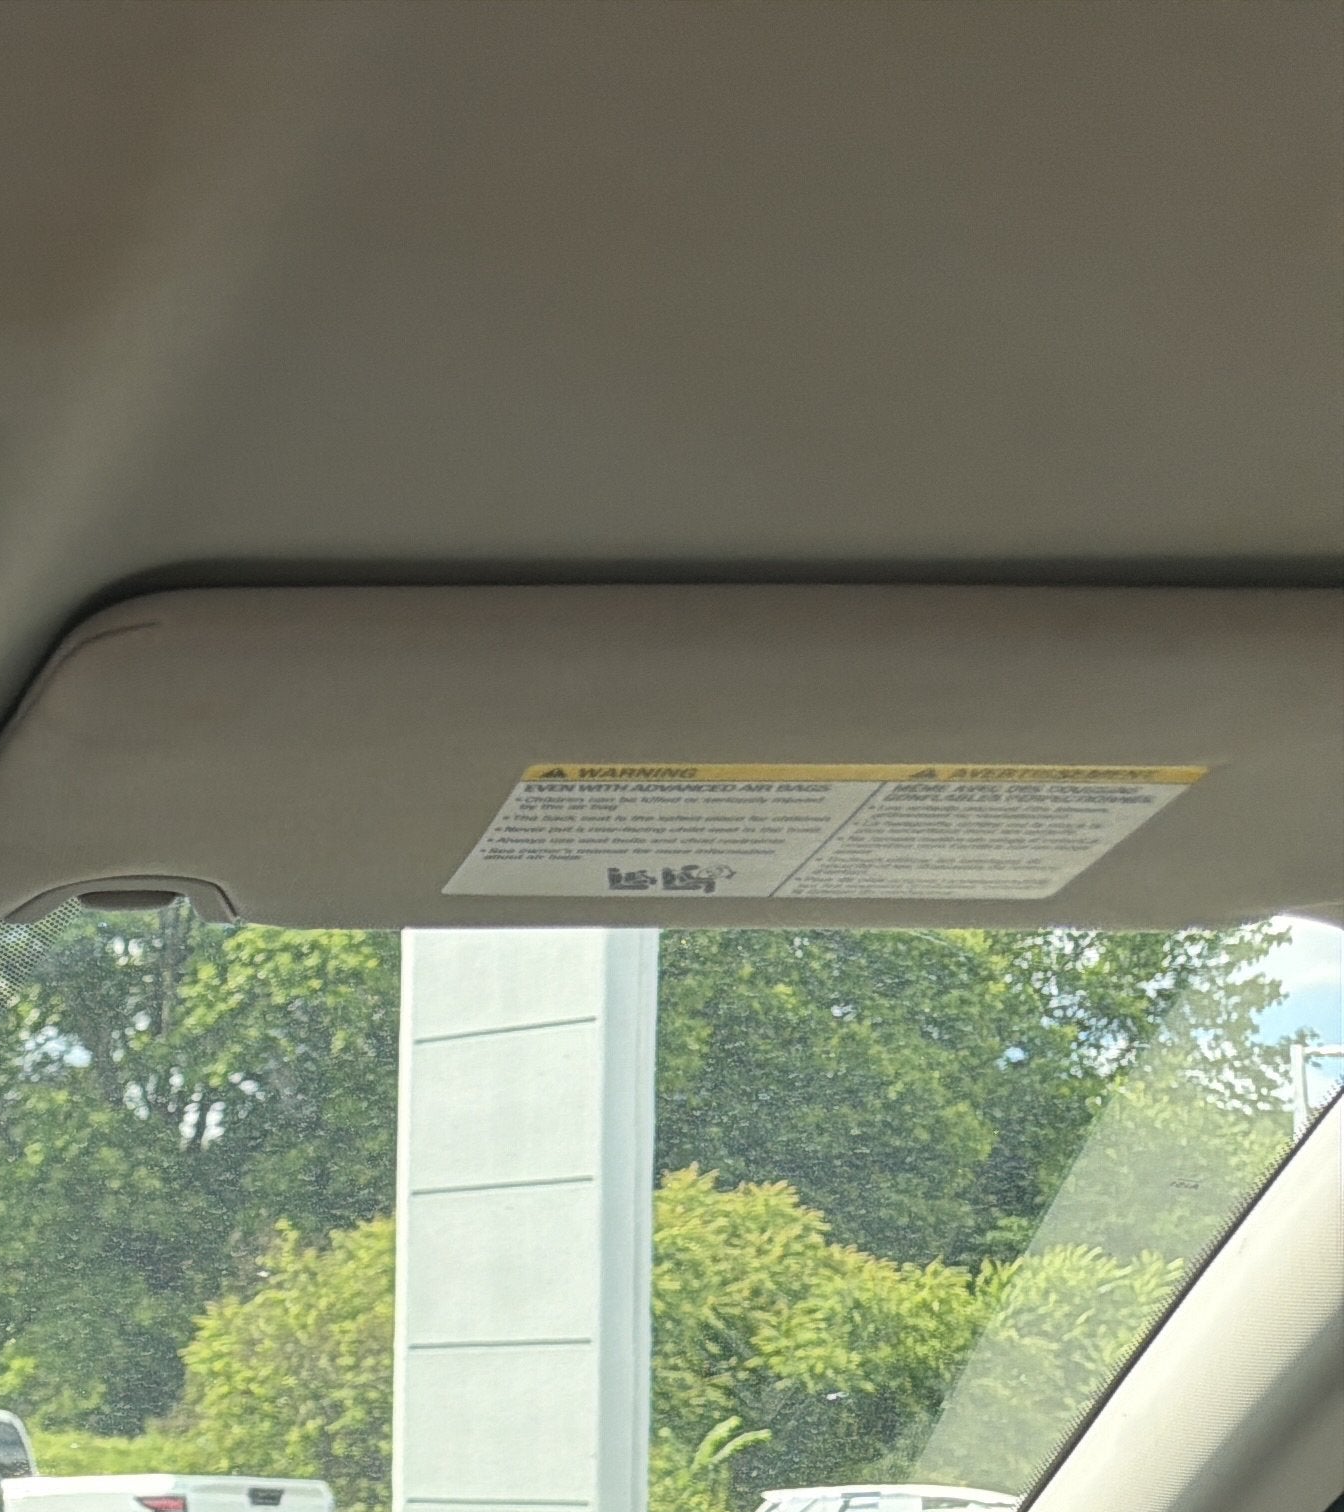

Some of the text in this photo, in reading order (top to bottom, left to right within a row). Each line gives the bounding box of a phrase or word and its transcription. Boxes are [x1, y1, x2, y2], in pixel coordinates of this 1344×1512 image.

[577, 767, 698, 779] WARNING
[524, 784, 576, 793] EVEN
[578, 784, 628, 793] WITH
[630, 784, 737, 793] ADVANCED
[739, 784, 773, 793] AIR
